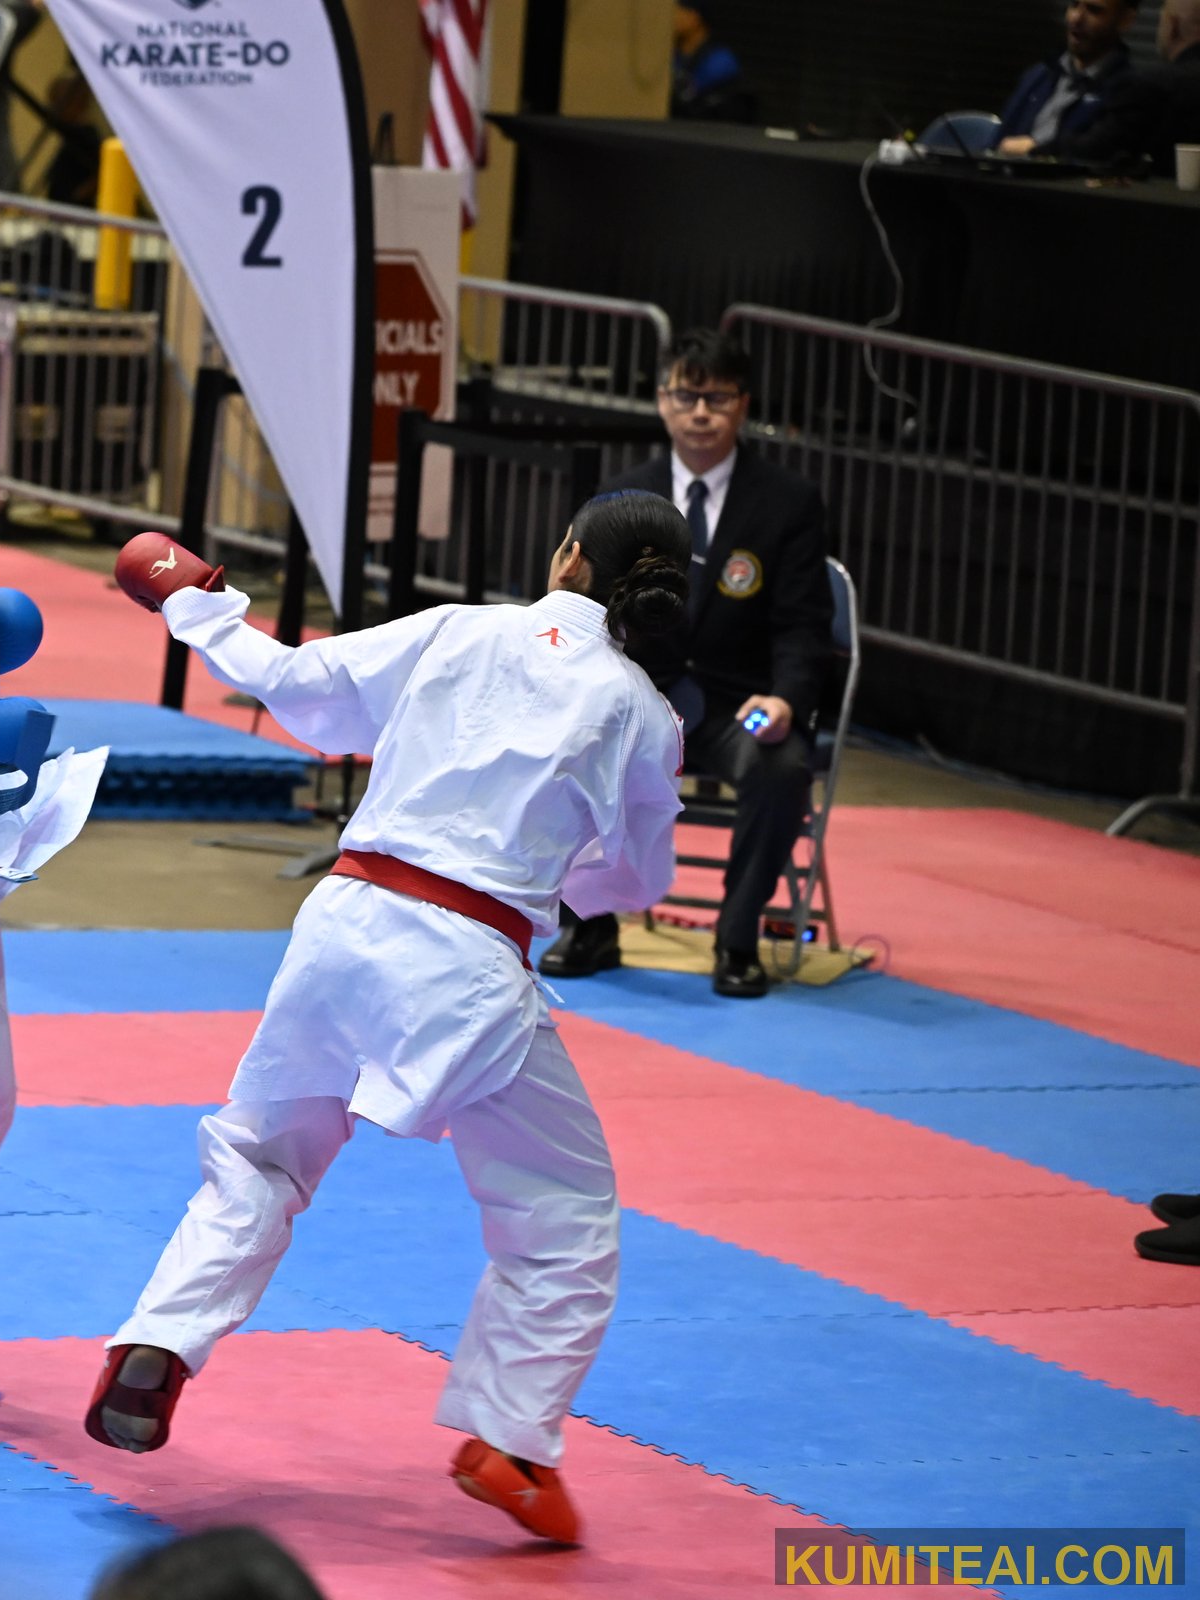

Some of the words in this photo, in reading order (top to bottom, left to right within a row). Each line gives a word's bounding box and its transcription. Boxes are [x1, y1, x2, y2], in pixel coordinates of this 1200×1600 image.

[137, 21, 249, 38] NATIONAL
[101, 40, 290, 67] KARATE-DO
[139, 70, 253, 87] FEDERATION
[241, 184, 283, 267] 2
[375, 320, 443, 354] ICIALS
[373, 371, 420, 406] NLY
